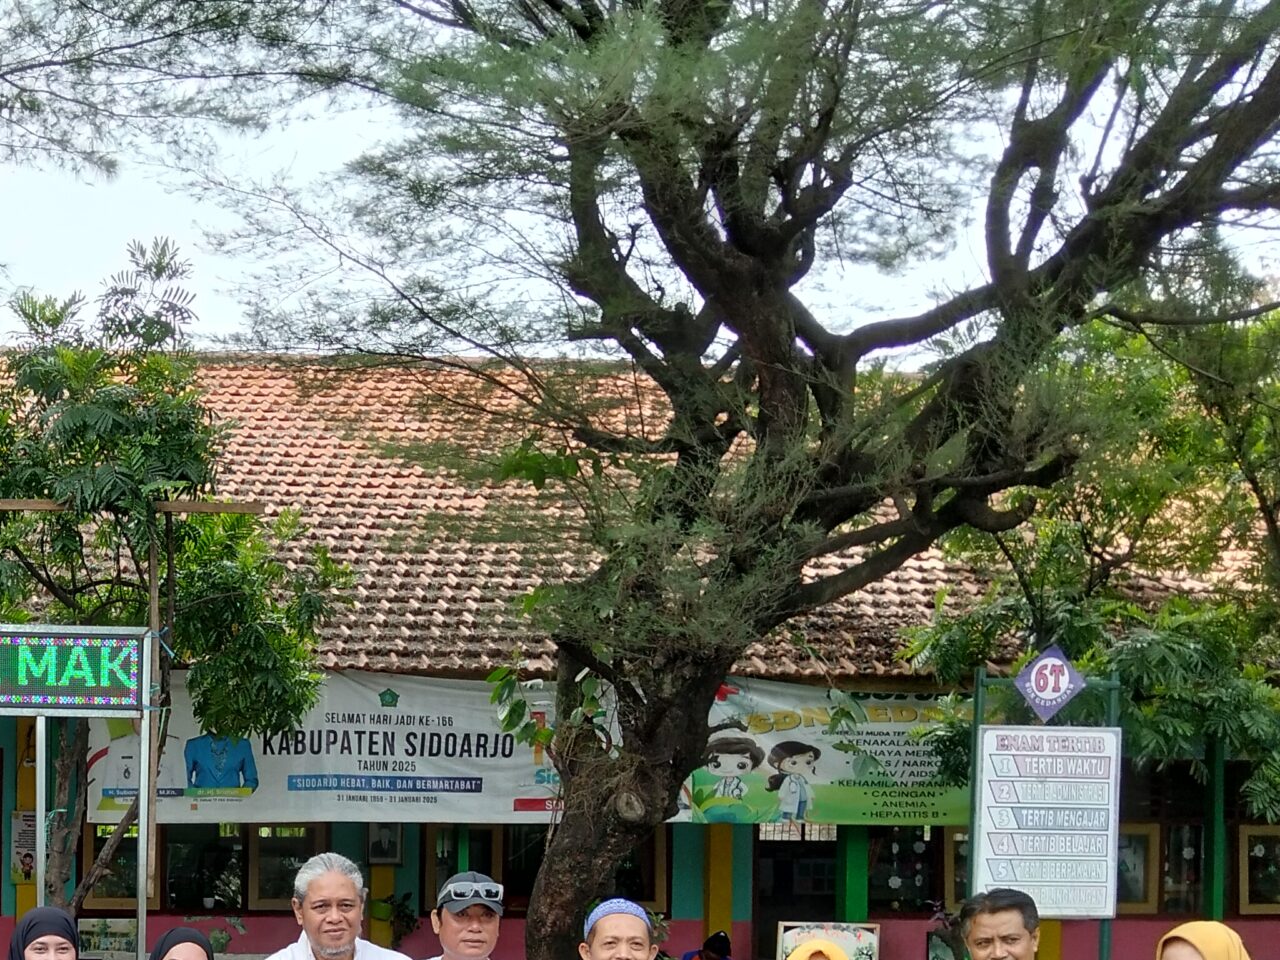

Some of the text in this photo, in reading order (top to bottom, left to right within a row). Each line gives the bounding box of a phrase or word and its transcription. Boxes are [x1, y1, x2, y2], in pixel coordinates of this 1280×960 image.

[17, 645, 137, 689] MAK
[1035, 664, 1065, 693] 6T
[324, 712, 454, 727] SELAMAT HARI JADI KE-166
[262, 729, 515, 758] KABUPATEN SIDOARJO
[995, 734, 1105, 754] ENAM TERTIB
[357, 759, 417, 772] TAHUN 2025
[1024, 757, 1064, 774] TERTIB
[1065, 758, 1105, 775] WAKTU
[908, 769, 936, 778] AIDS
[396, 779, 413, 790] DAN
[837, 779, 908, 788] KEHAMILAN
[871, 790, 936, 798] CACINGAN
[881, 800, 928, 809] ANEMIA
[870, 811, 929, 819] HEPATITIS
[1021, 809, 1054, 826] TERTIB
[1056, 810, 1106, 828] MENGAJAR
[1021, 836, 1056, 853] TERTIB
[1059, 837, 1103, 854] BELAJAR
